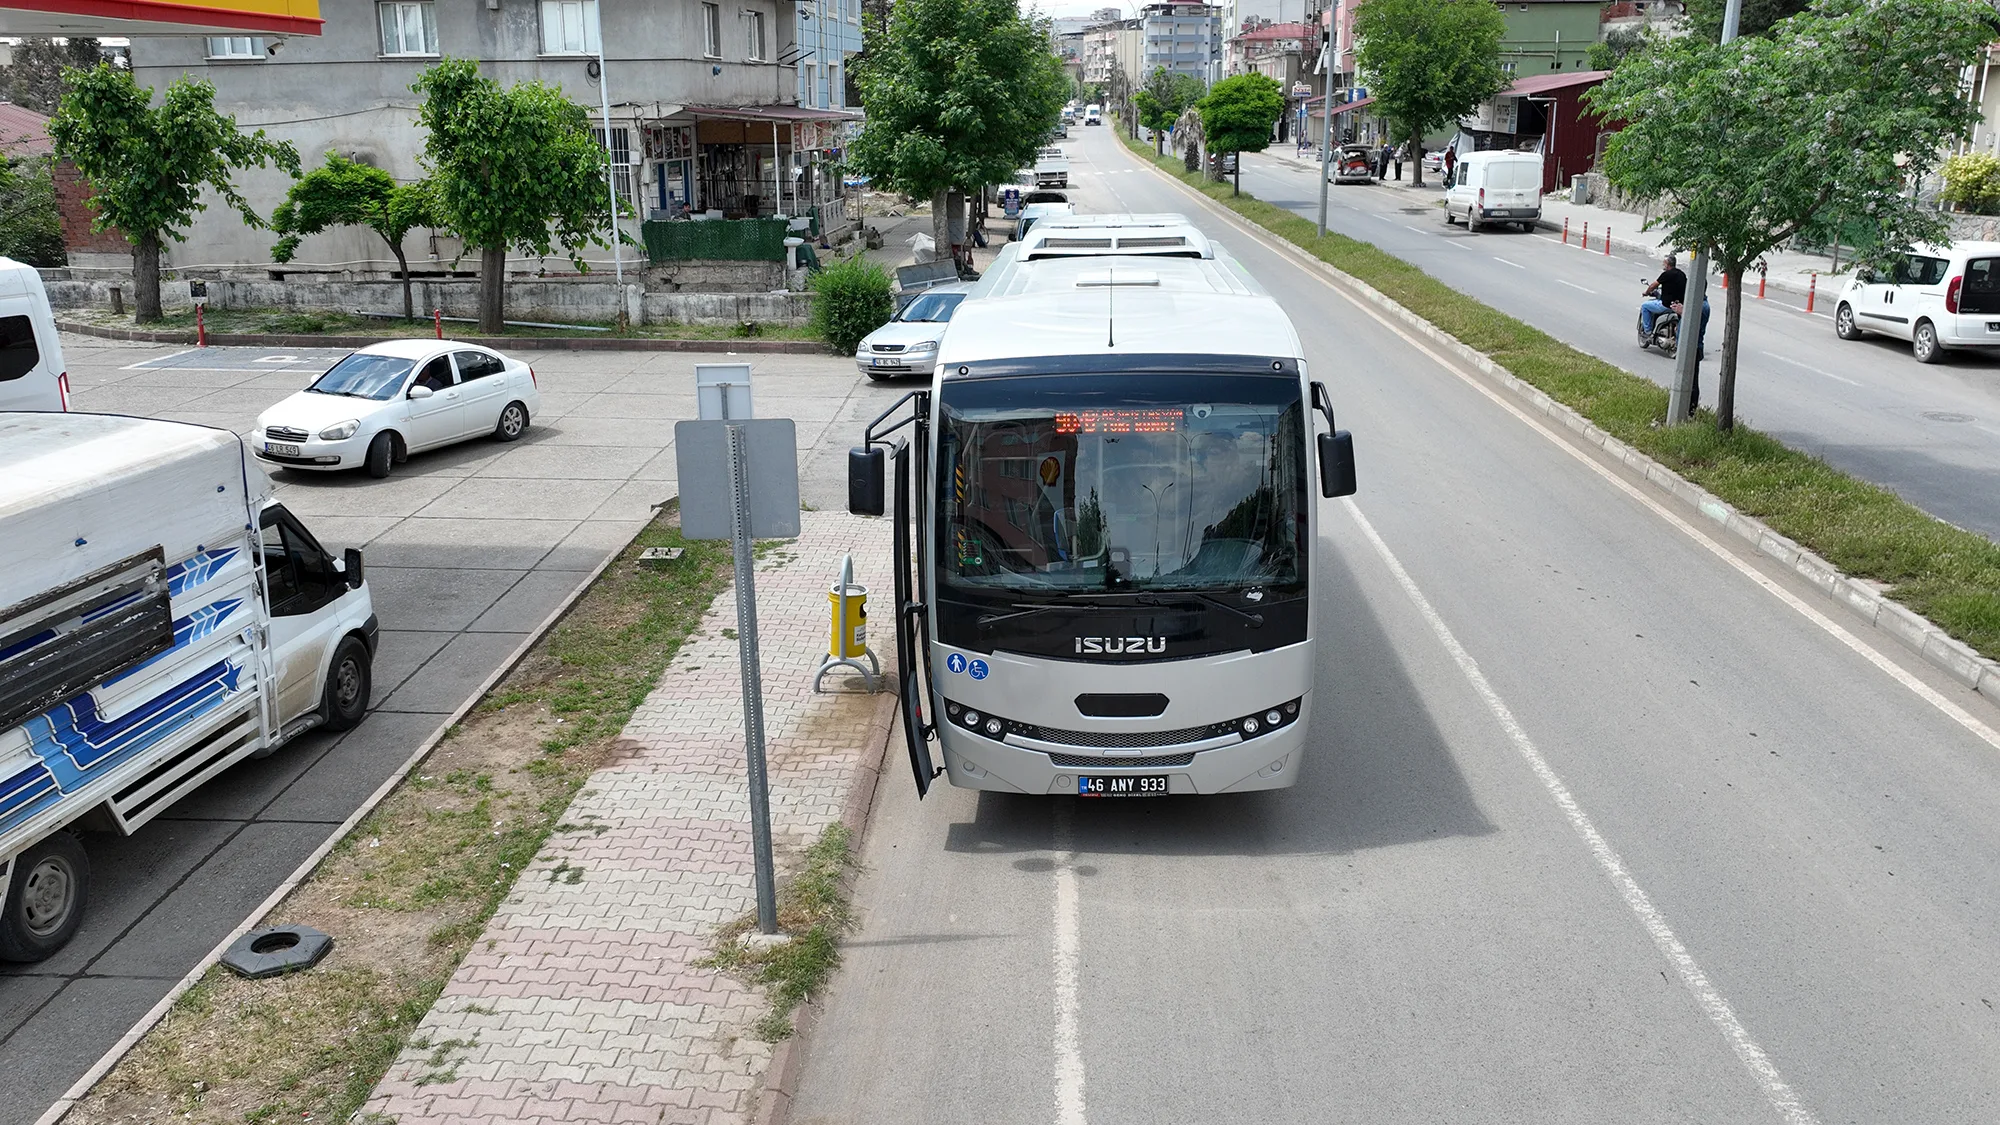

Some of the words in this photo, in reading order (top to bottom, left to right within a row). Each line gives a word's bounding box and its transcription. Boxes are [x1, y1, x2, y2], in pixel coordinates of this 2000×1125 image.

[1075, 637, 1166, 653] ISUZU
[1088, 778, 1104, 792] 46
[1110, 778, 1135, 792] ANY
[1140, 777, 1166, 791] 933
